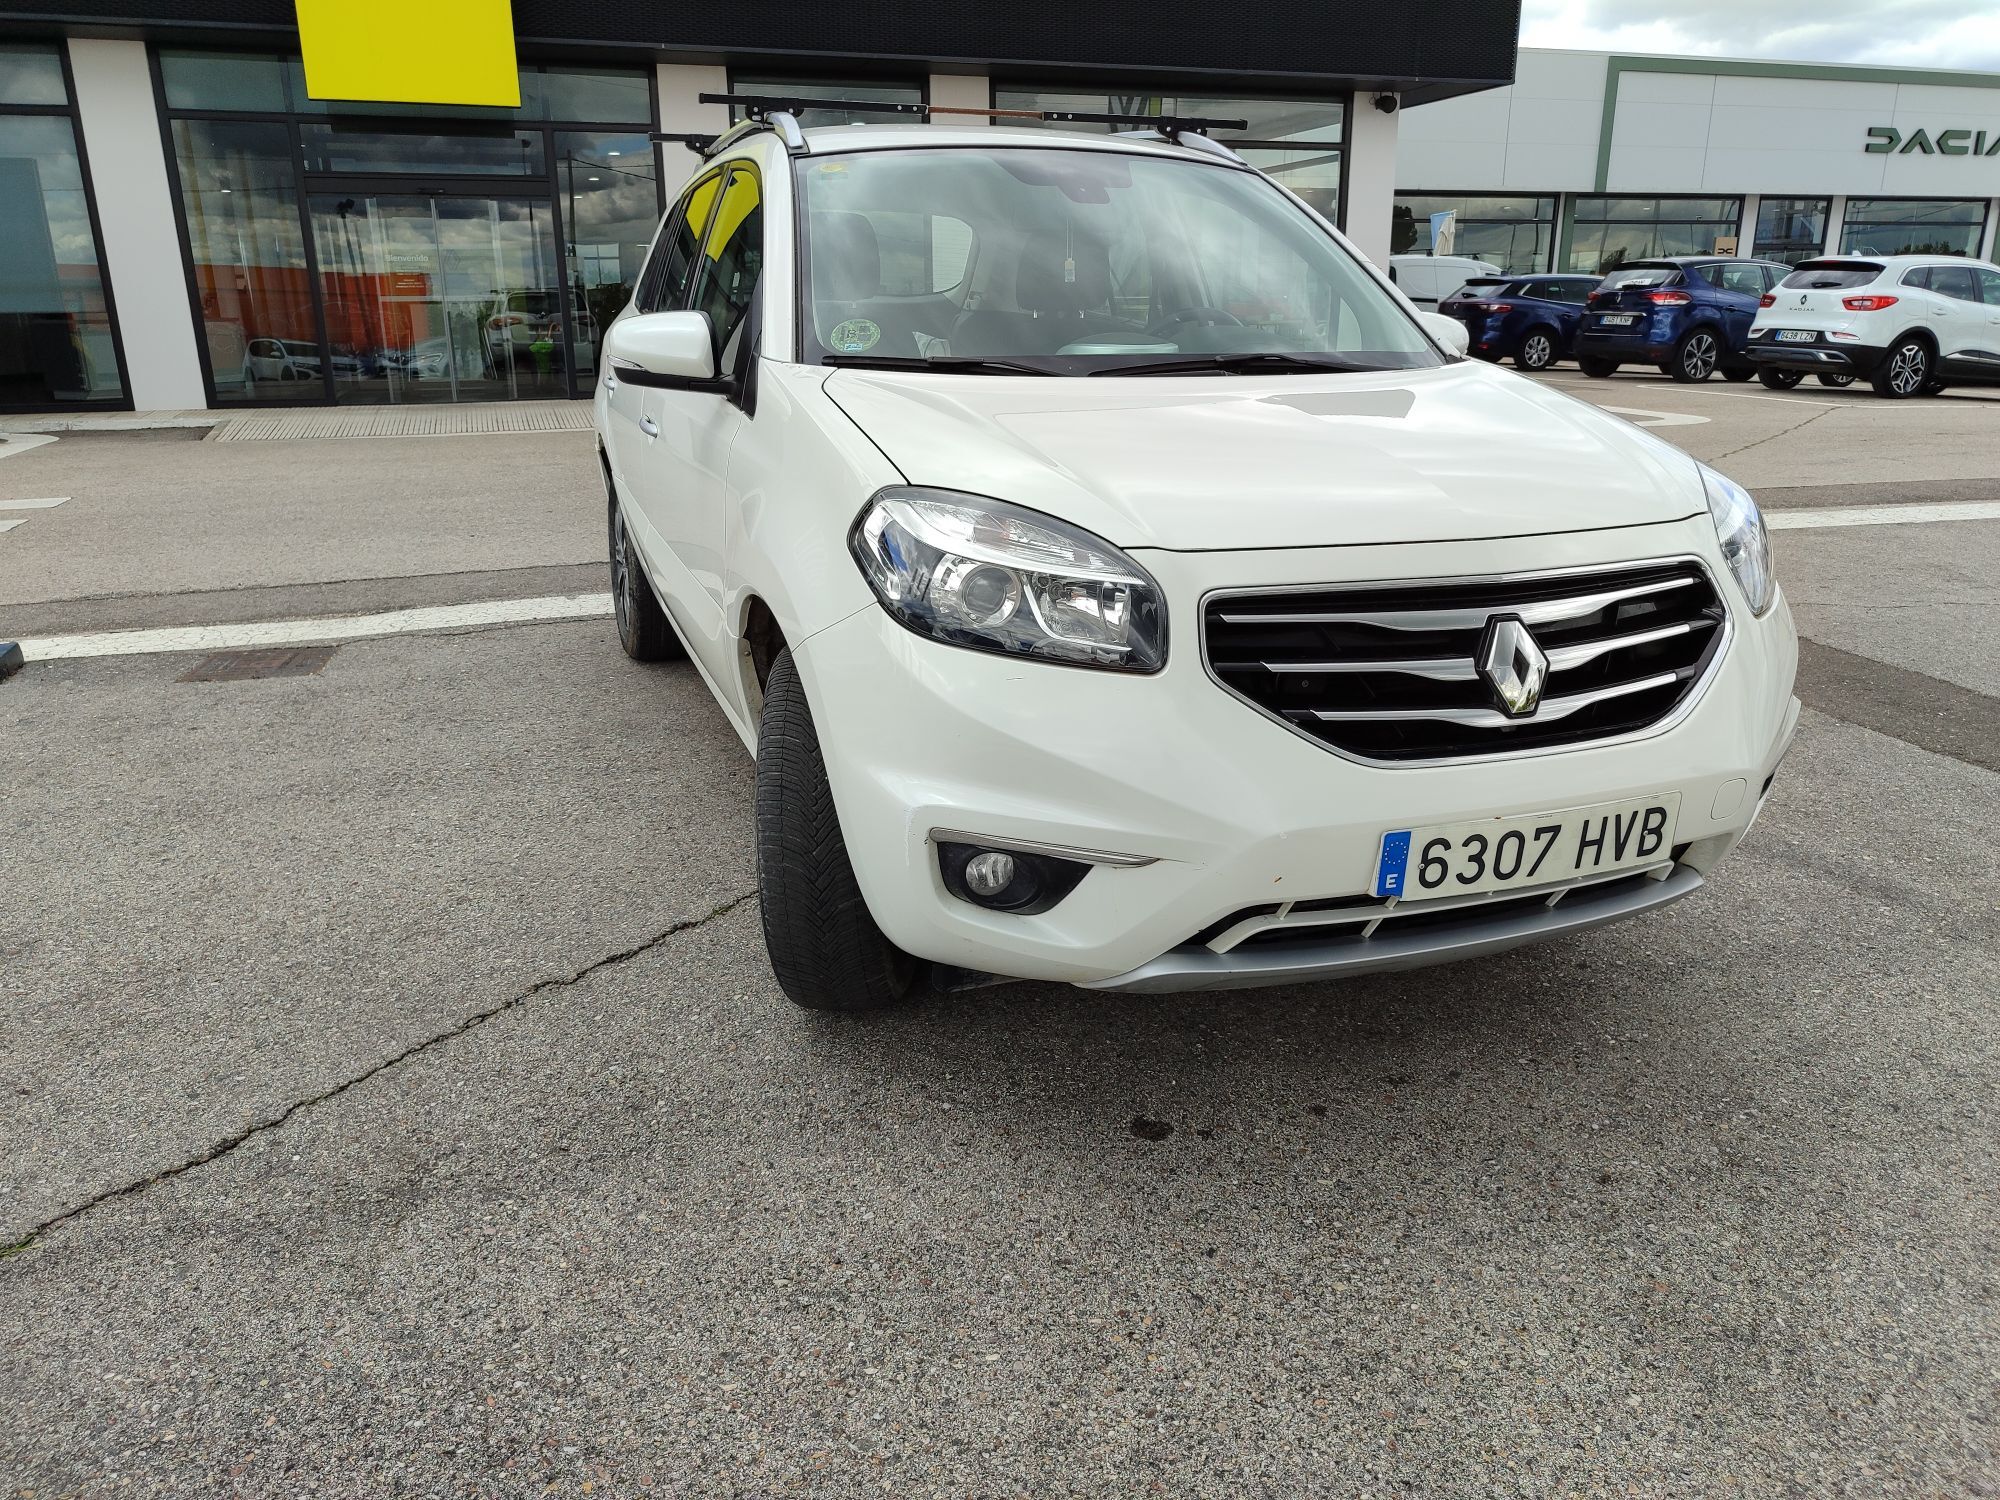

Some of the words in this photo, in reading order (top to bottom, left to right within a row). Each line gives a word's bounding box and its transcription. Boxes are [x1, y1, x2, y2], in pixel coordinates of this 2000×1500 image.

[385, 254, 429, 262] Bienvenido
[1780, 331, 1799, 340] 6438
[1799, 332, 1816, 341] LZN
[1385, 873, 1398, 889] E
[1418, 824, 1562, 889] 6307
[1574, 806, 1667, 869] HVB
